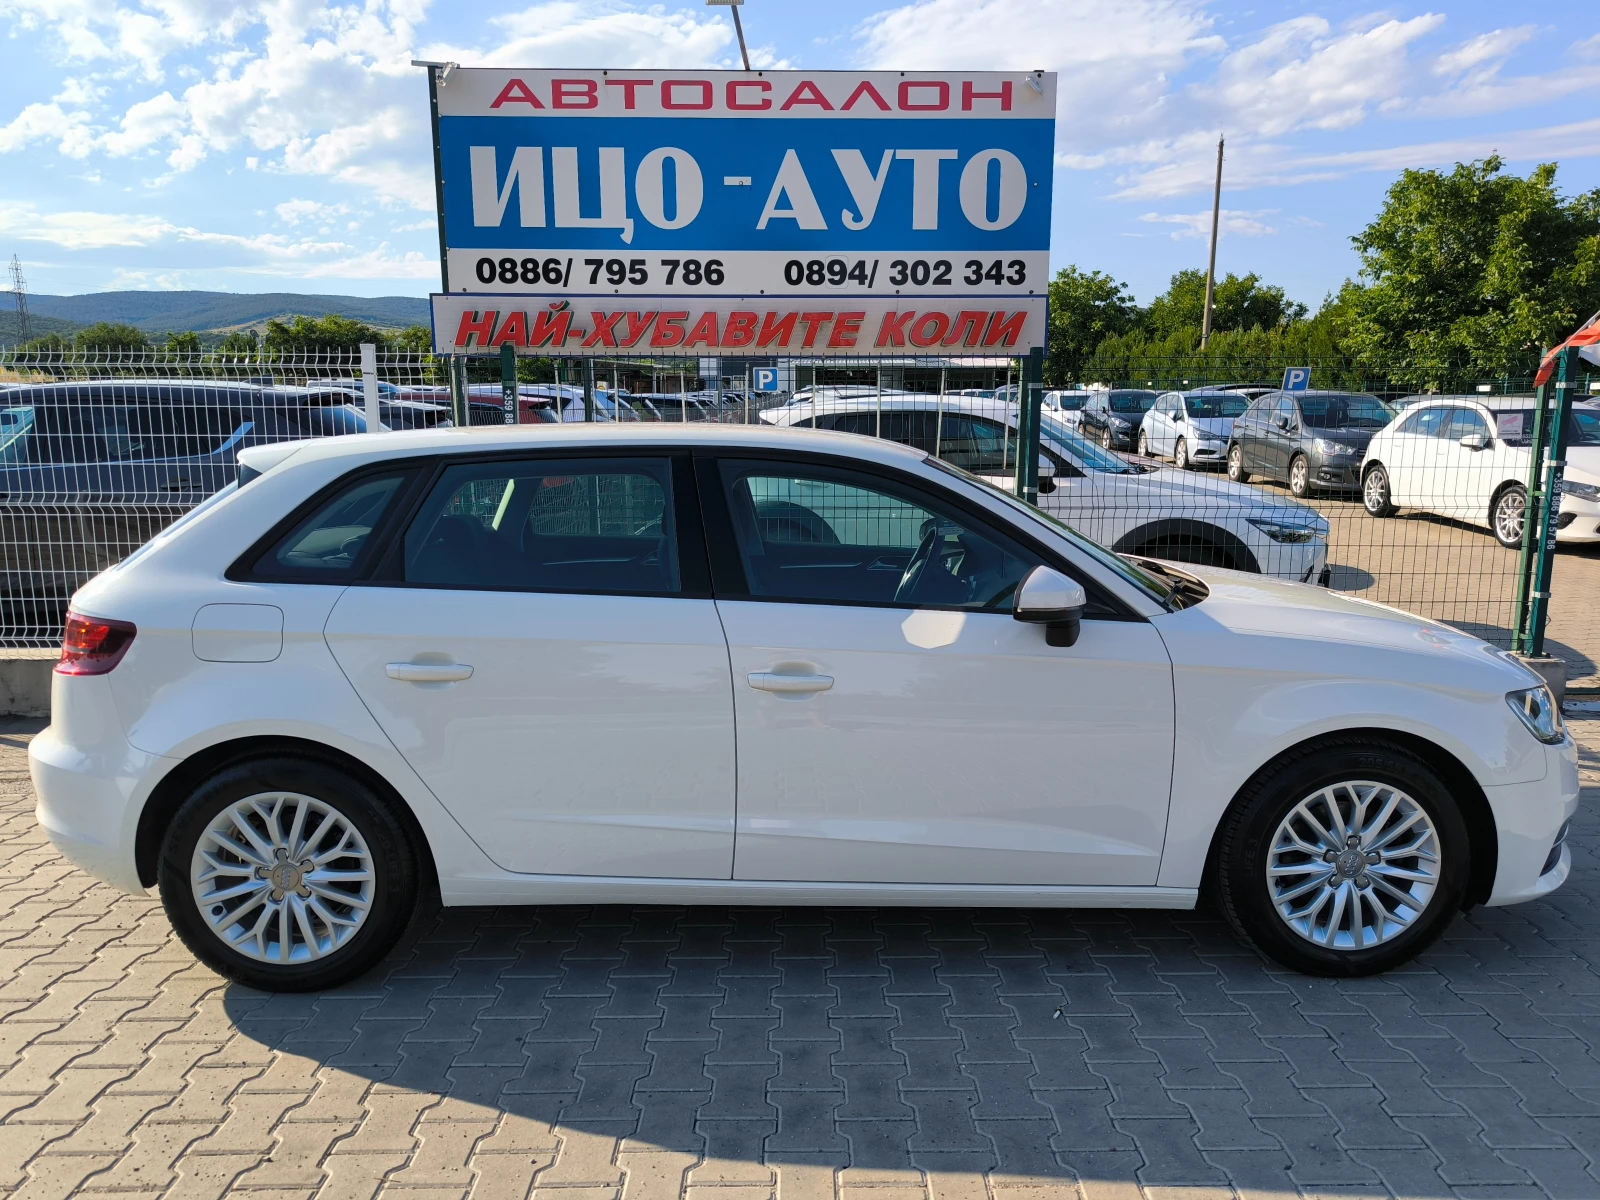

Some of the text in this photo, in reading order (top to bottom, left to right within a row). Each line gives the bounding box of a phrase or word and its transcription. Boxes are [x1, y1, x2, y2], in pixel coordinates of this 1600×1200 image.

[490, 79, 1012, 111] АВТОСАЛОН
[476, 258, 724, 287] 0886/ 795 786
[784, 259, 1026, 288] 0894/ 302 343
[454, 301, 1026, 348] НАЙ-ХУБАВИТЕ КОЛИ
[758, 370, 773, 389] P
[1288, 370, 1304, 389] P
[504, 389, 513, 411] +359
[1547, 472, 1563, 550] +359 886 79 57 86
